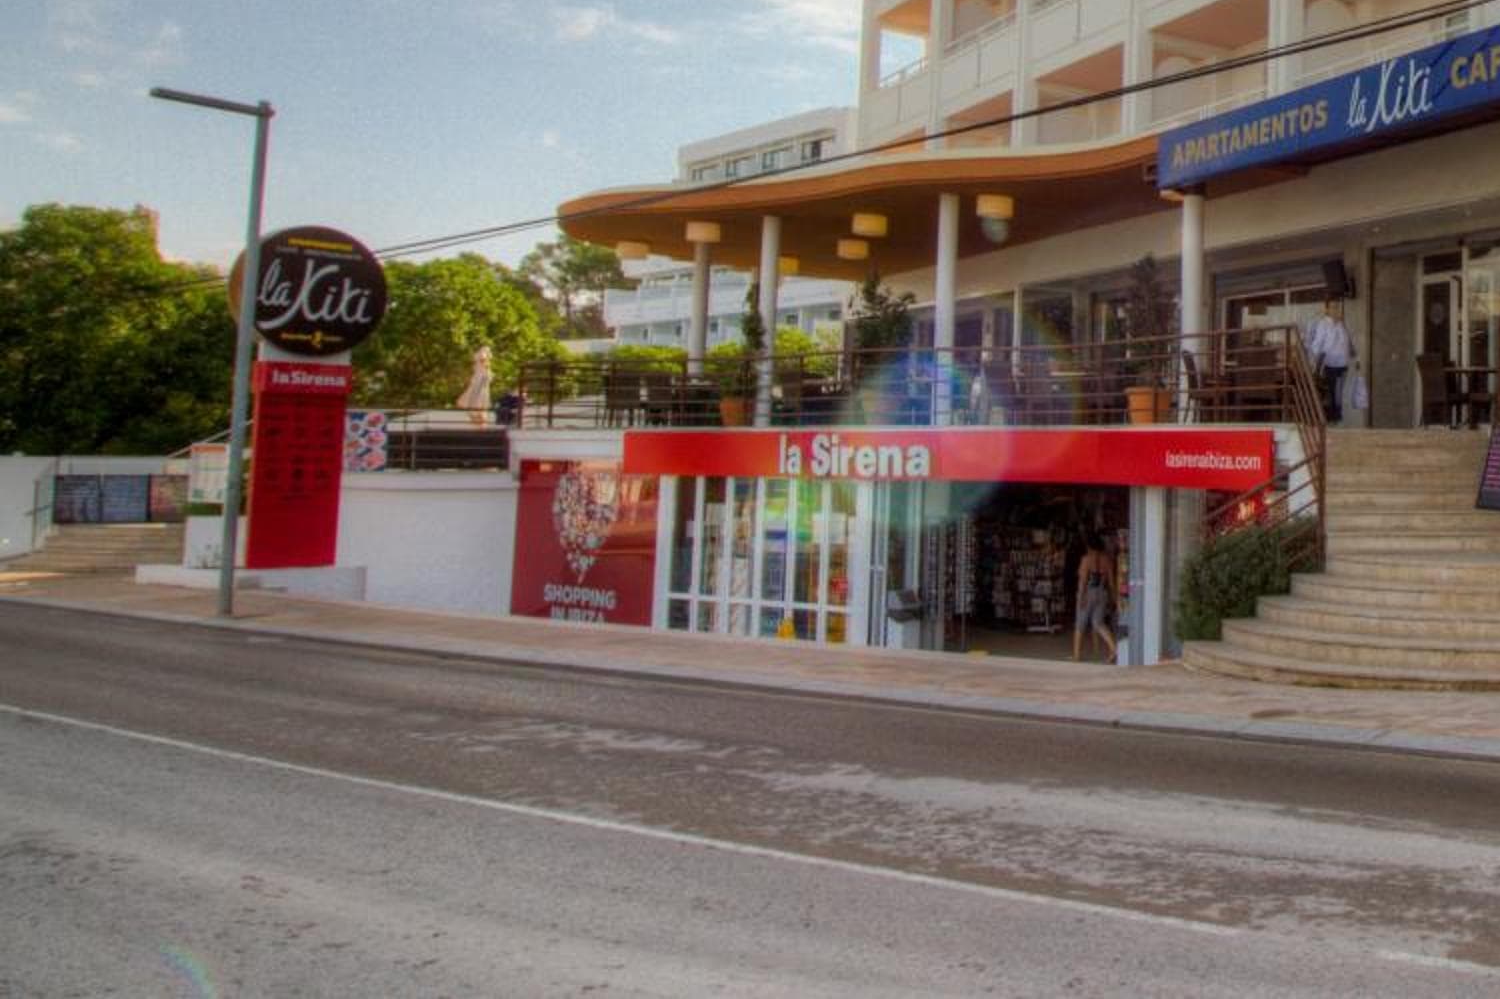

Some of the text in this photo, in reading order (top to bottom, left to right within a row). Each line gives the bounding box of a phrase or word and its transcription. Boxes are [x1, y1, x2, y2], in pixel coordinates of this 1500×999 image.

[1173, 100, 1328, 169] APARTAMENTOS
[1348, 75, 1367, 128] la
[257, 257, 293, 307] la
[779, 432, 931, 477] la Sirena
[544, 583, 617, 611] SHOPPING
